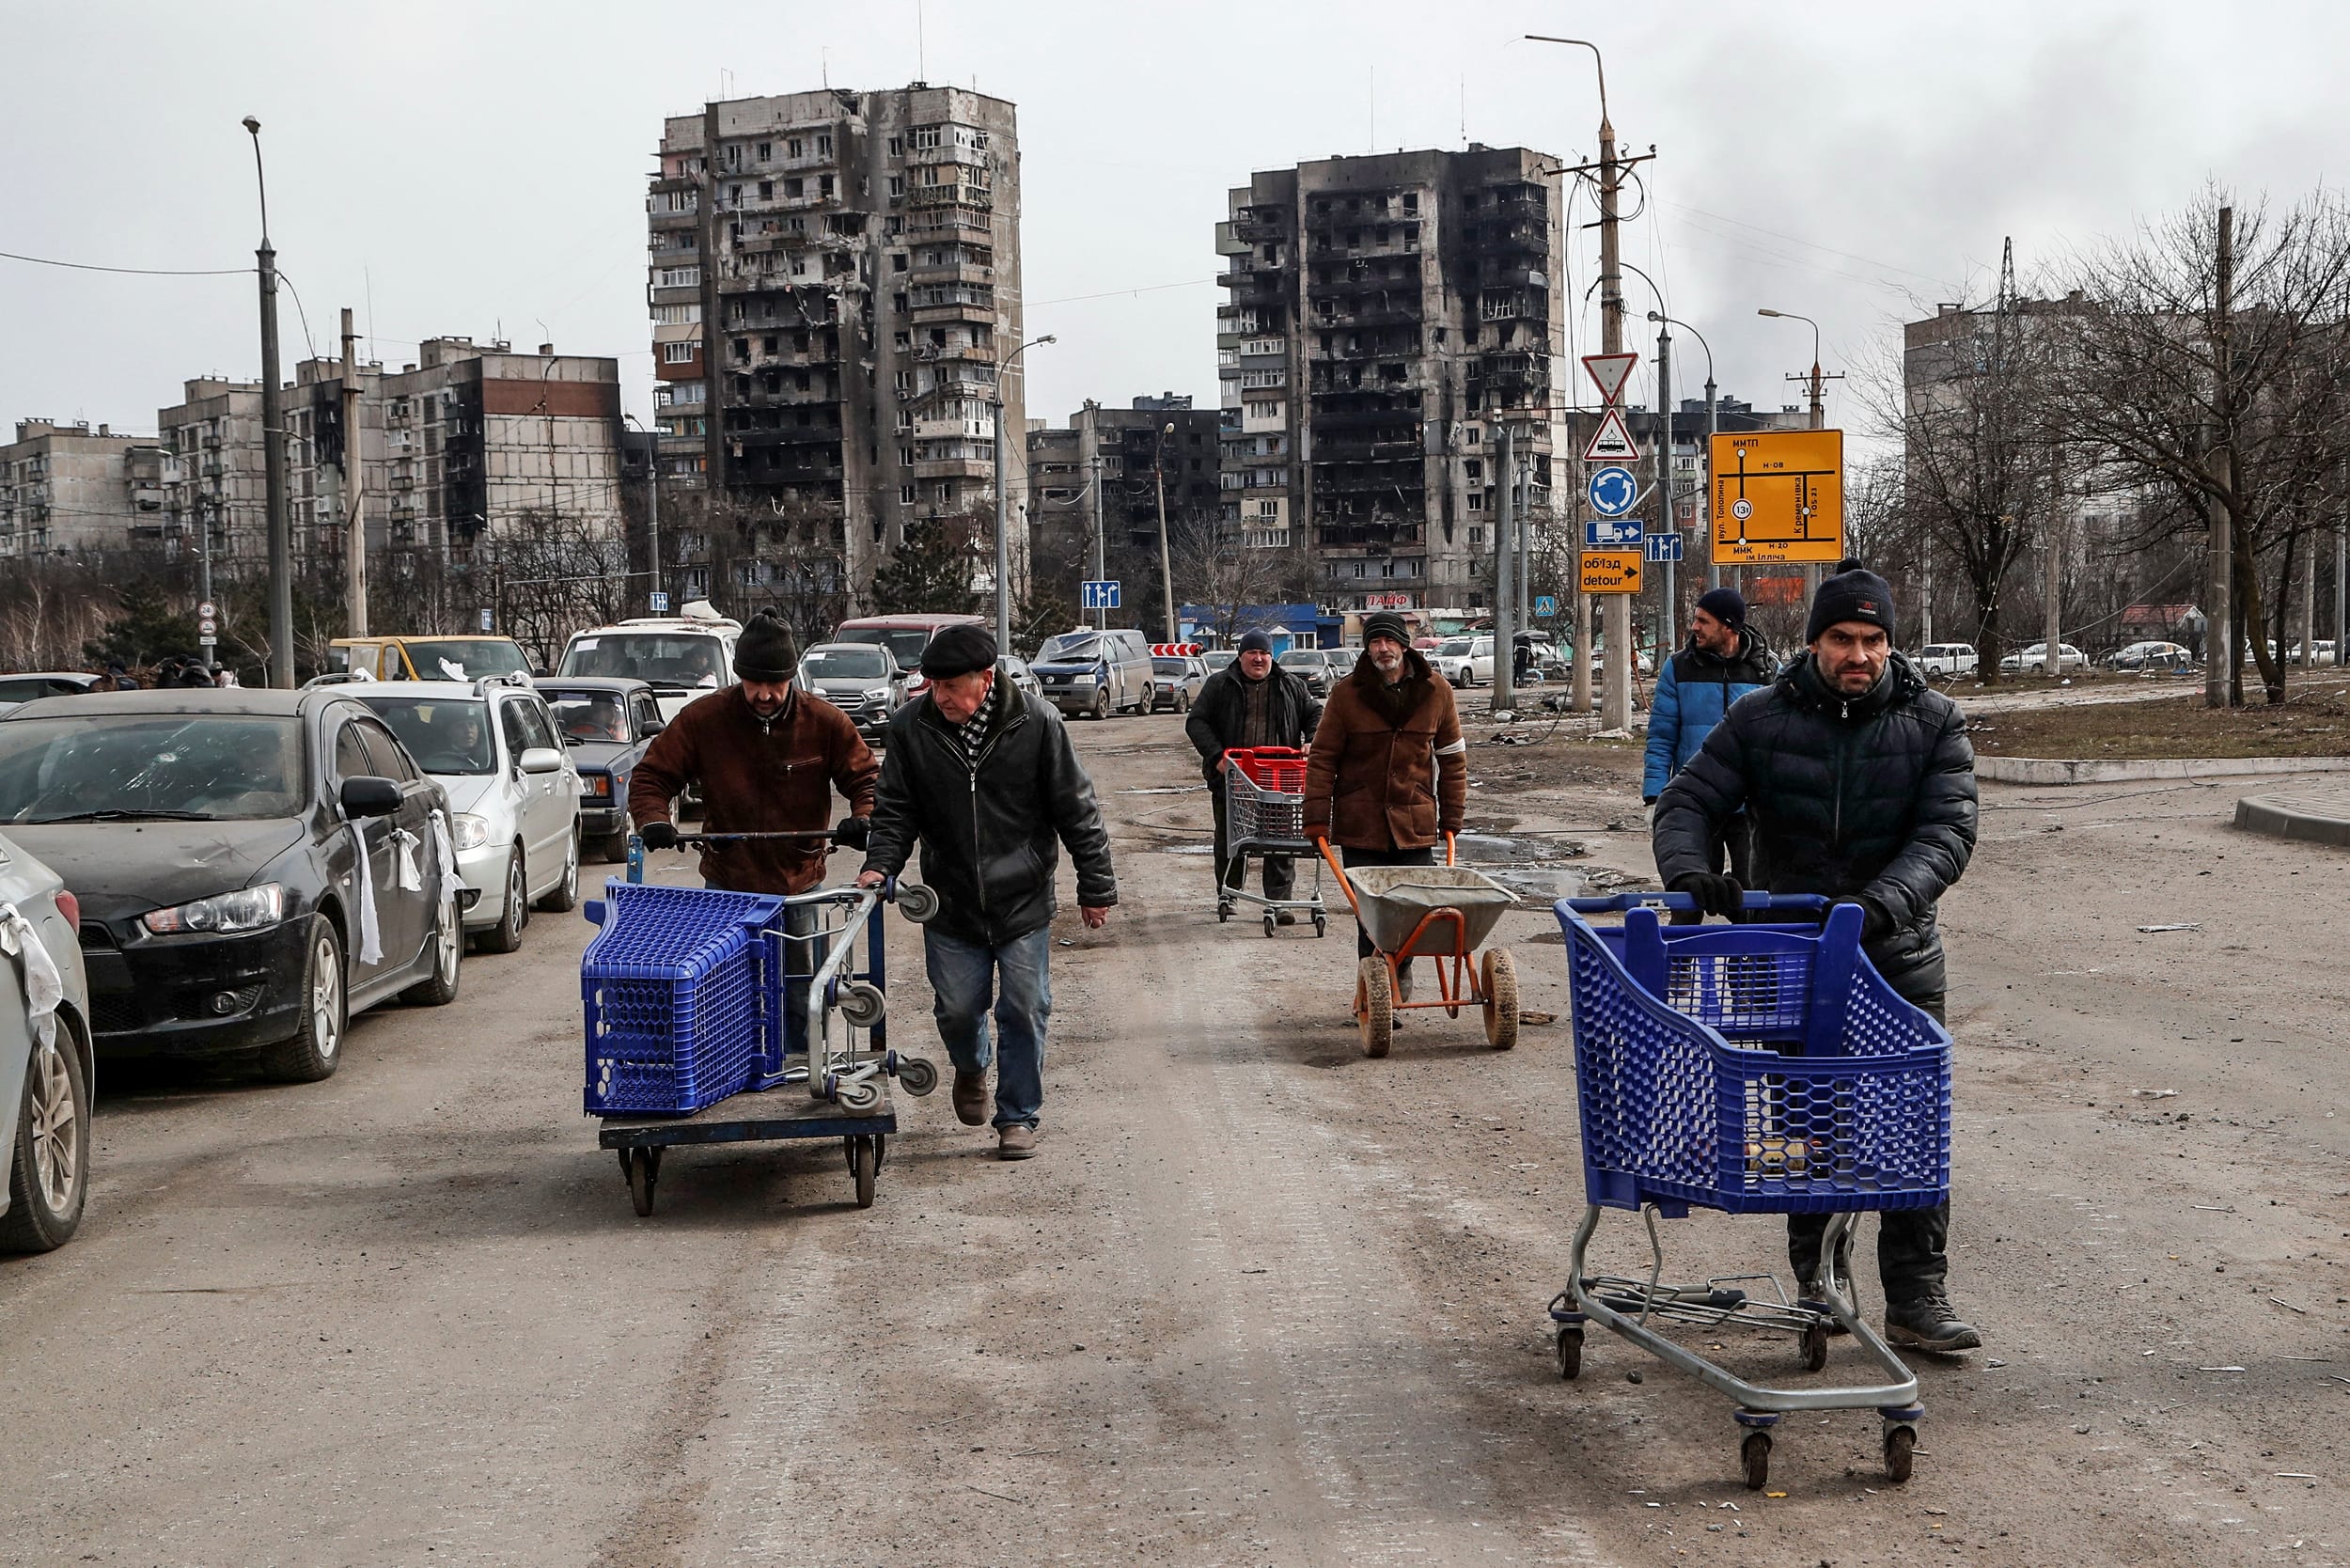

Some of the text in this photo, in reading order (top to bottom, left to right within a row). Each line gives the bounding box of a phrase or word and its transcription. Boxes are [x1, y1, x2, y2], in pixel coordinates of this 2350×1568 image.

[1732, 438, 1759, 448] ММТП
[1716, 479, 1727, 540] вул. Тополина
[1732, 546, 1753, 555] ММК
[1583, 574, 1623, 586] detour
[1366, 590, 1408, 605] ЛАЙФ
